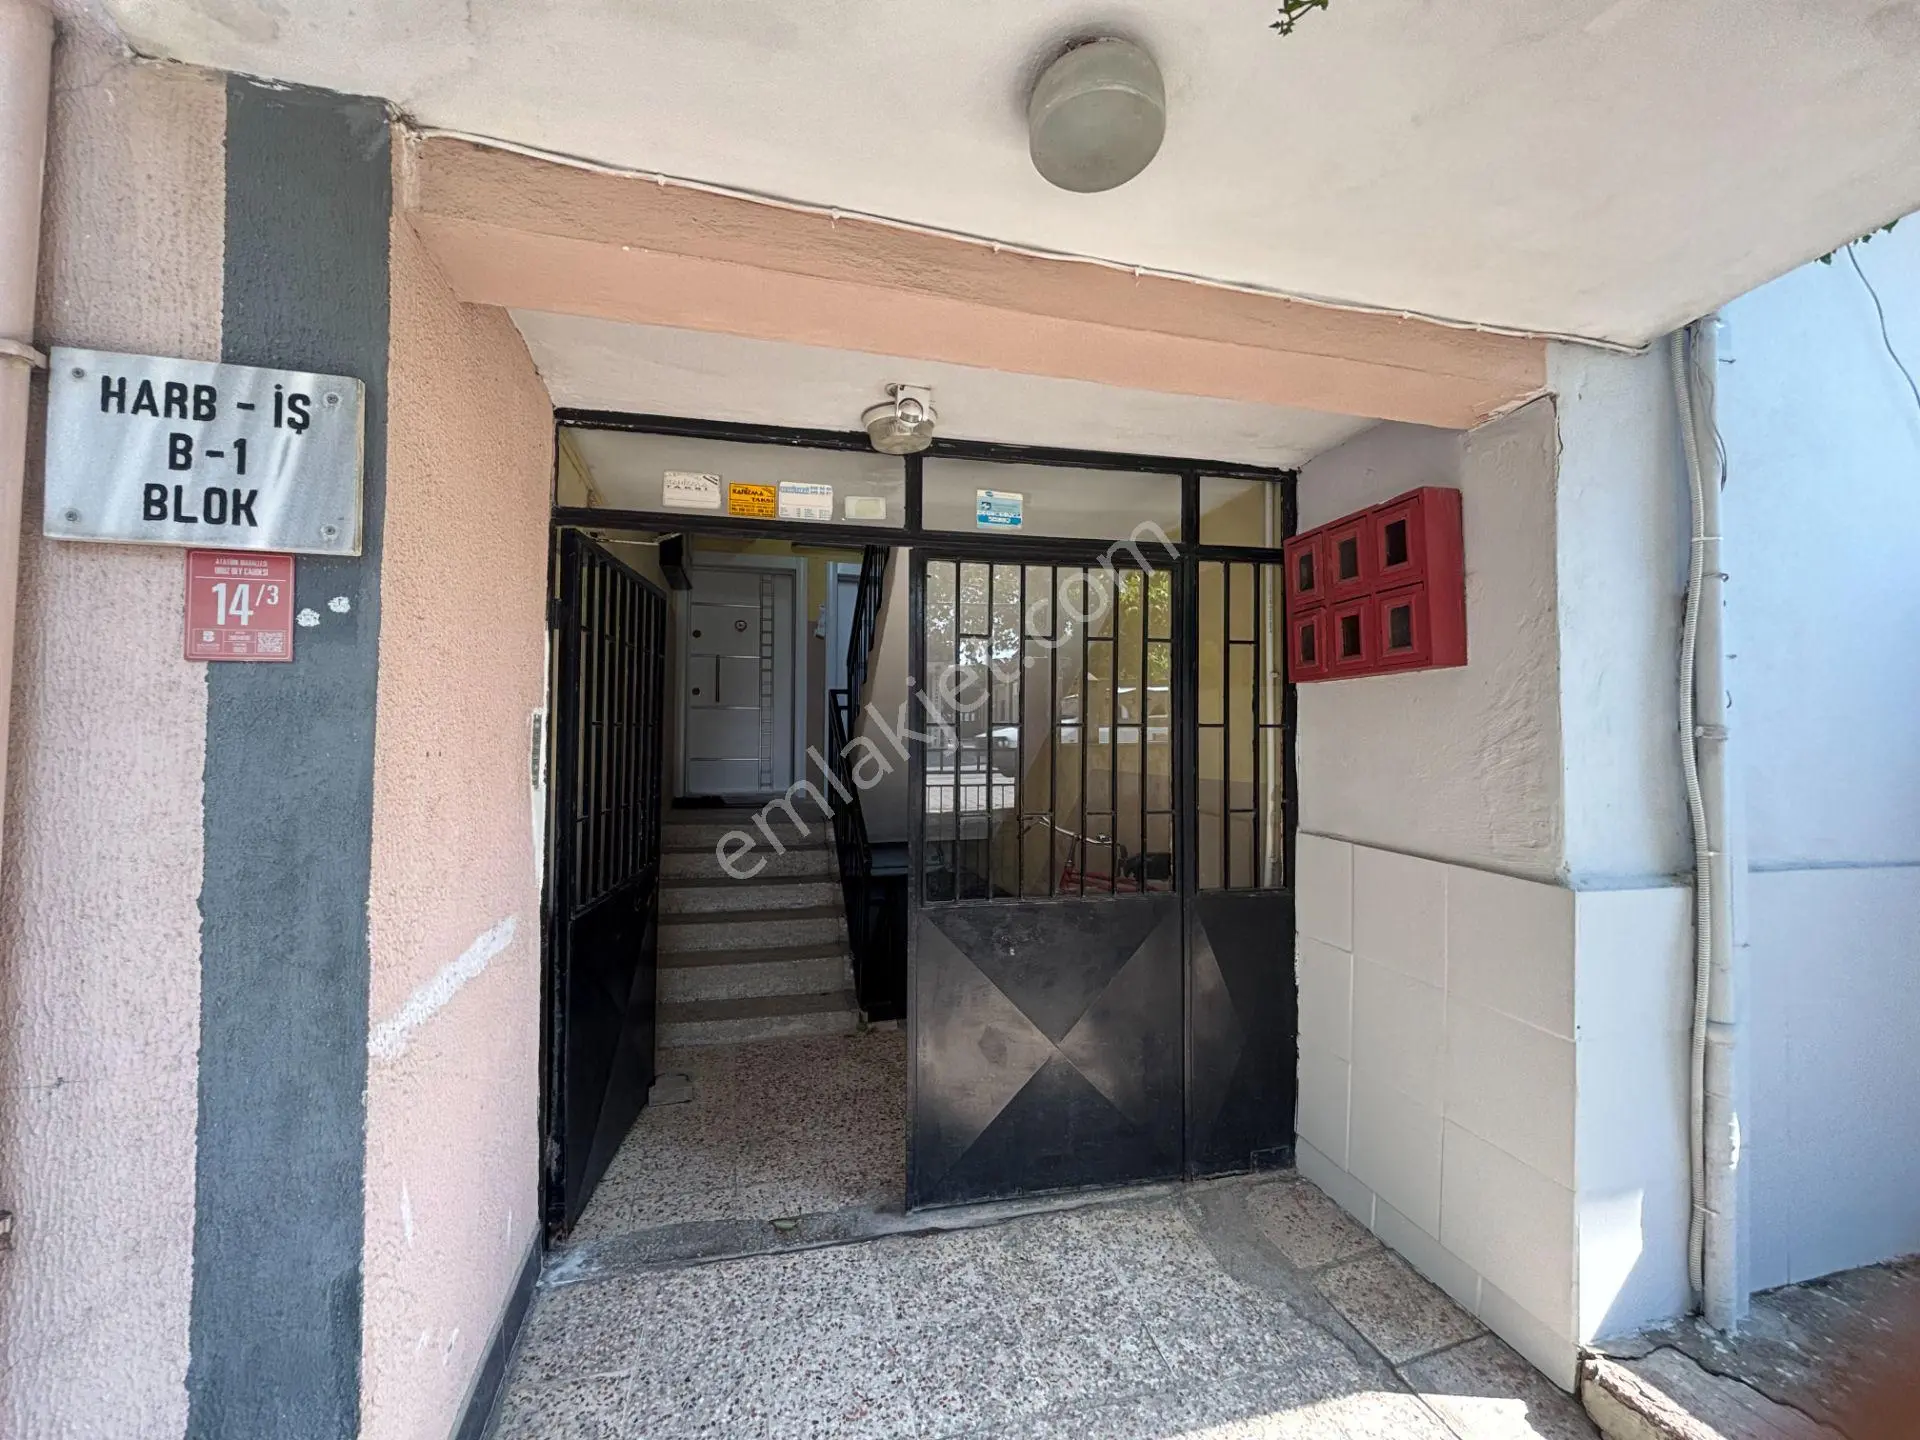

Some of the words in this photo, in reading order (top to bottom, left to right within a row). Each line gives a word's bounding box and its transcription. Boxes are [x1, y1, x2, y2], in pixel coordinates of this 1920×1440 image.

[101, 375, 217, 421] HARB
[273, 384, 311, 434] İŞ
[142, 482, 259, 527] BLOK
[211, 582, 279, 626] 14/3
